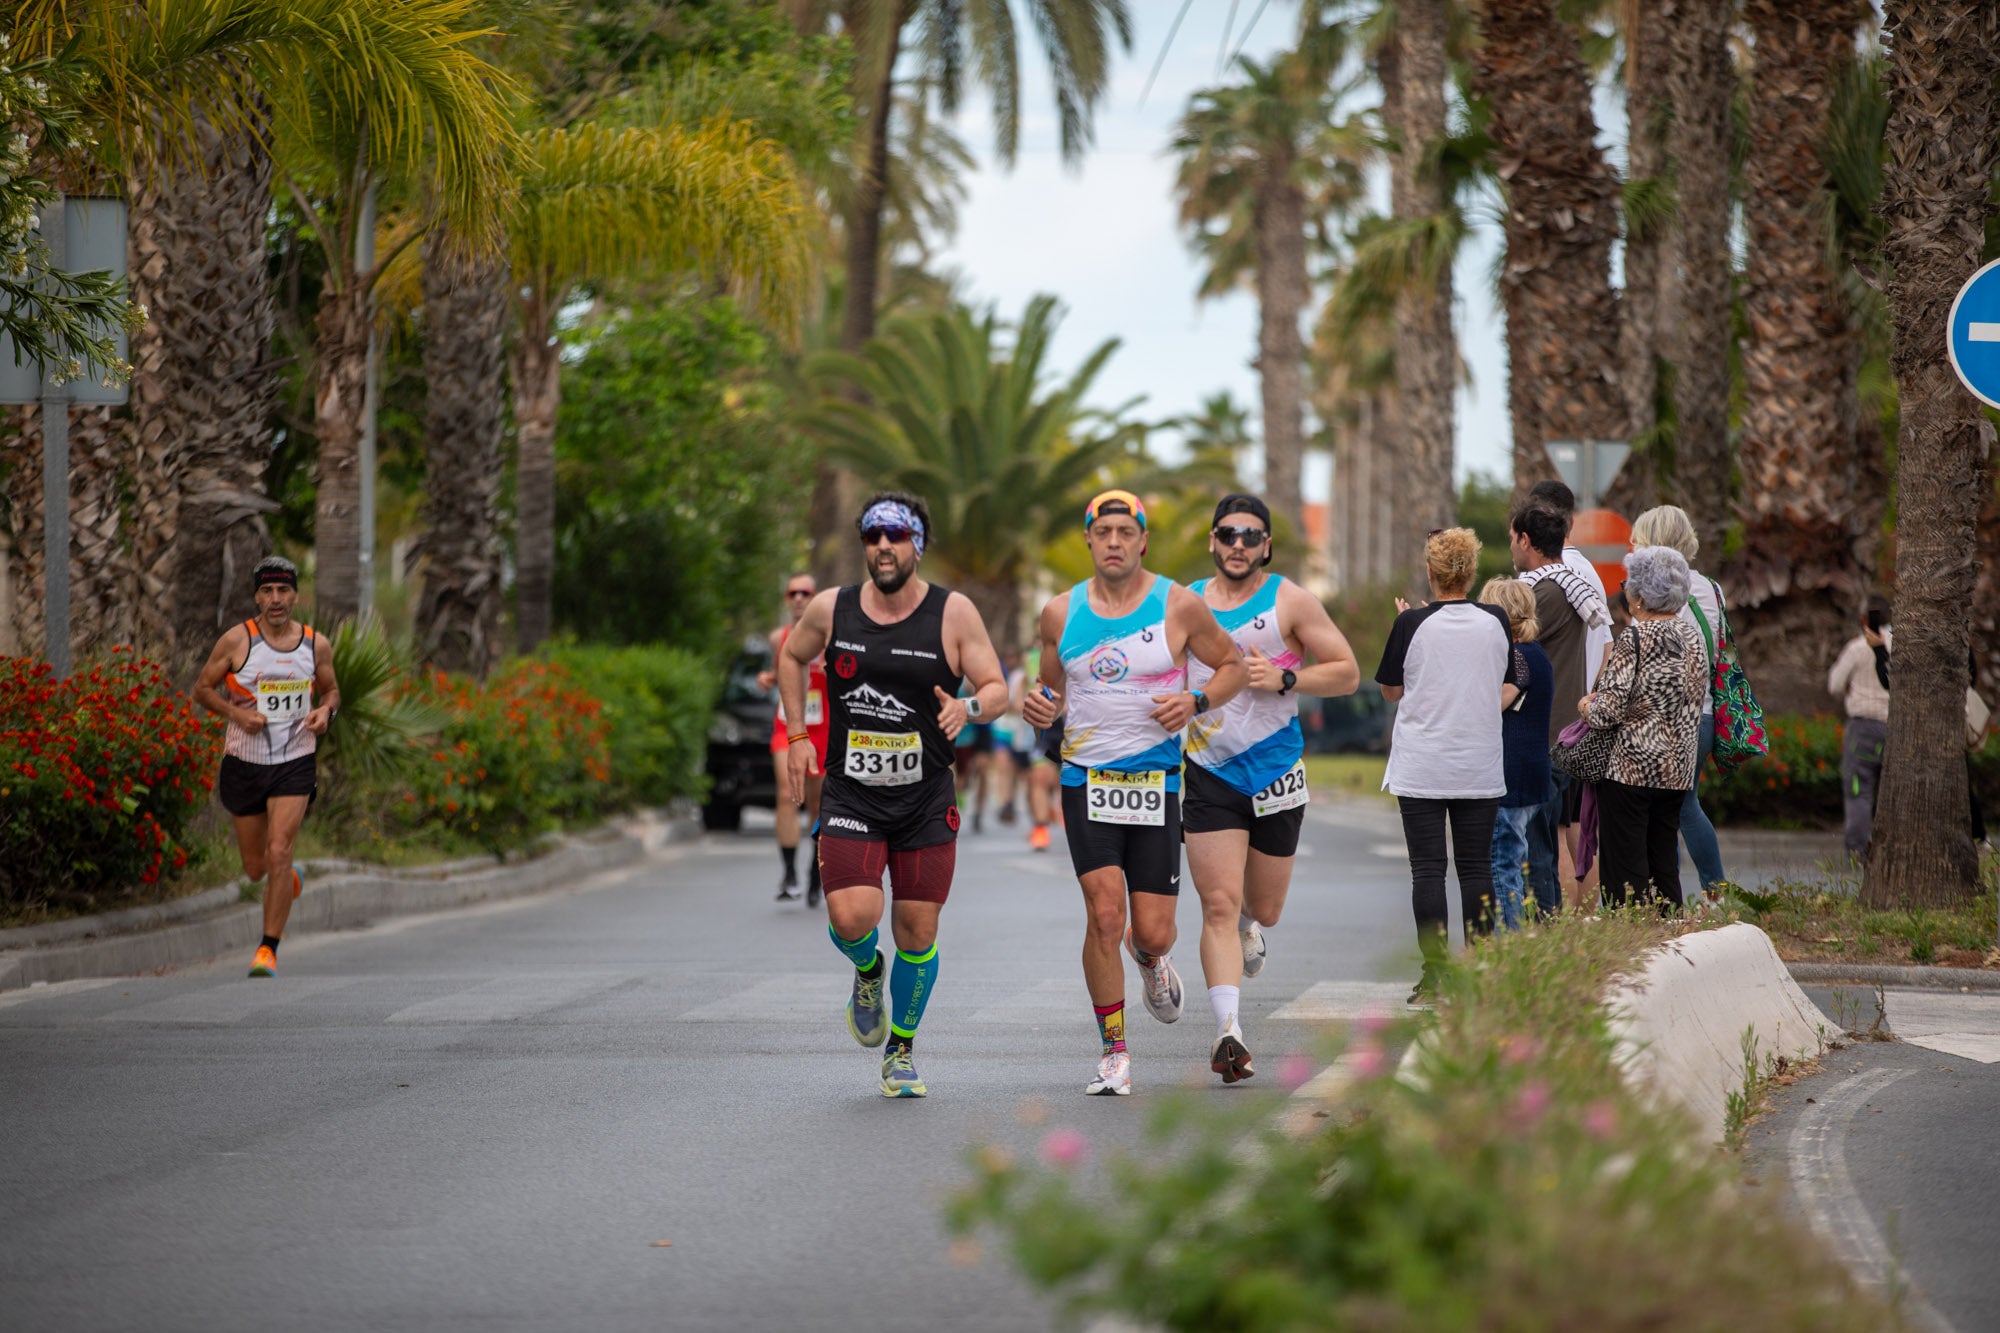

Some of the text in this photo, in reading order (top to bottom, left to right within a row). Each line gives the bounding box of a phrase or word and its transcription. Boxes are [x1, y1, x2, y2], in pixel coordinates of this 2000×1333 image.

[835, 640, 866, 653] MOLINA
[267, 694, 303, 711] 911
[859, 735, 870, 745] 38
[849, 751, 919, 775] 3310
[1091, 788, 1161, 811] 3009
[827, 816, 868, 833] MOLINA
